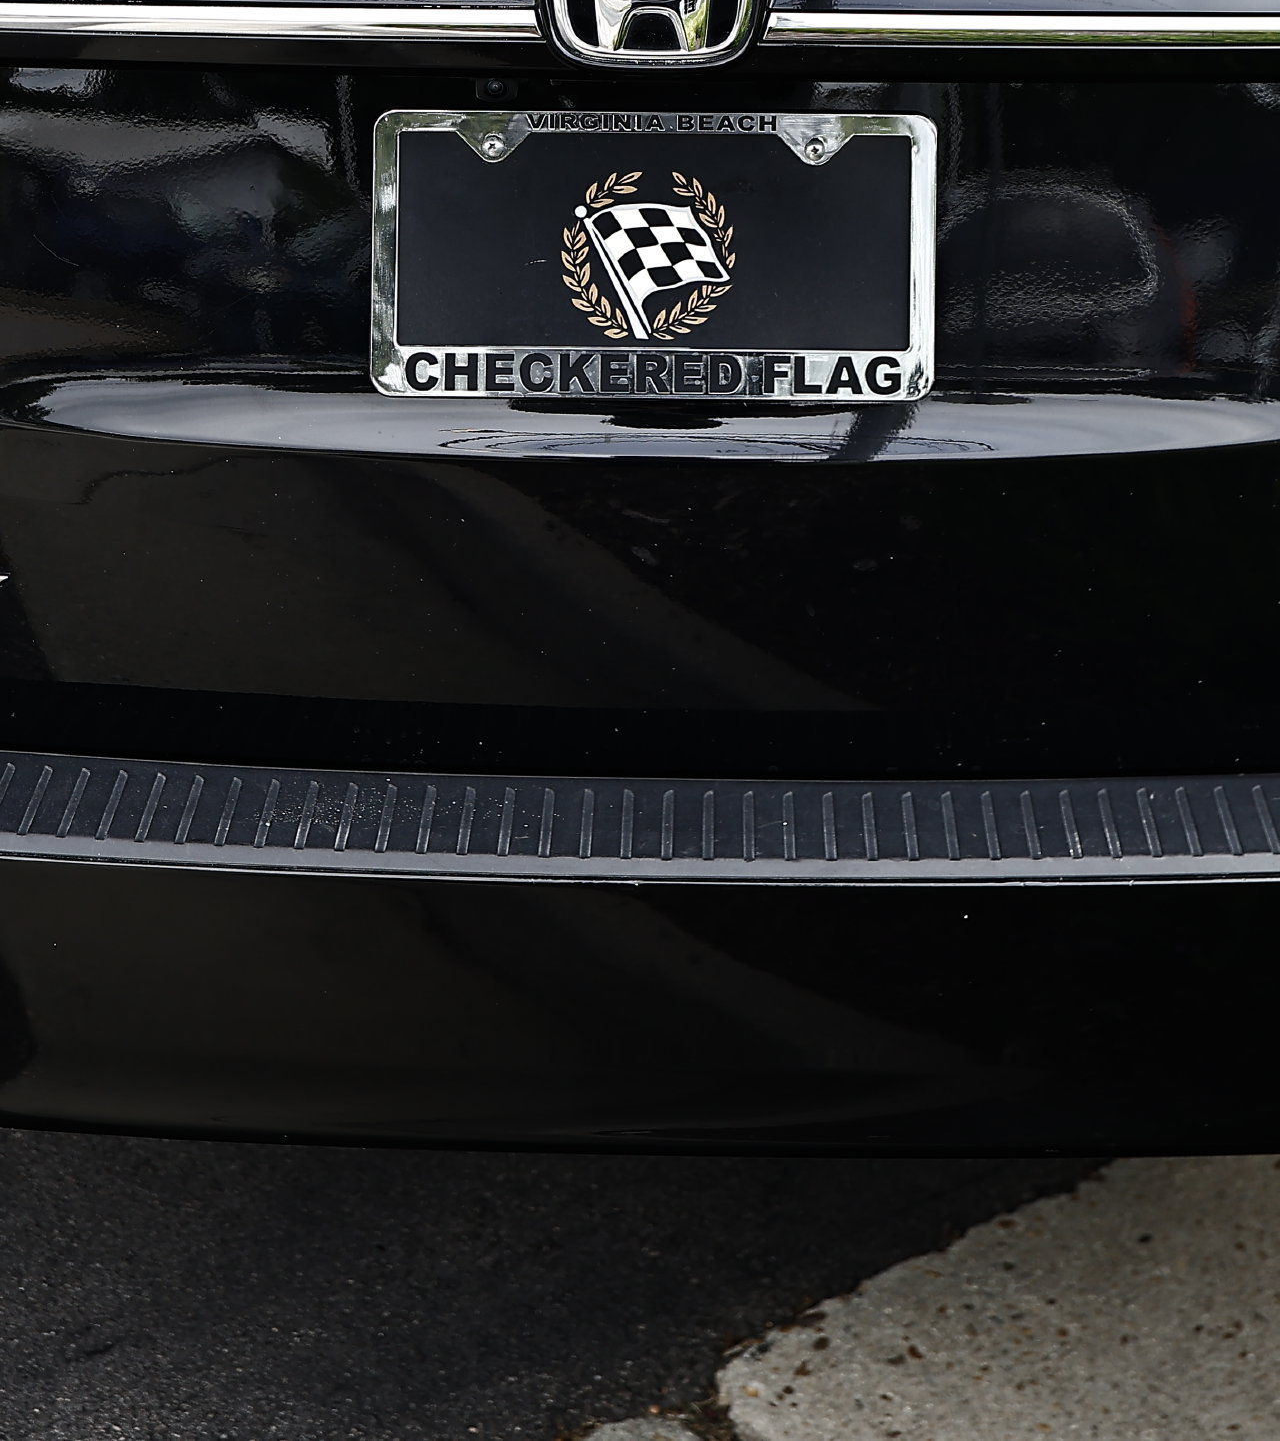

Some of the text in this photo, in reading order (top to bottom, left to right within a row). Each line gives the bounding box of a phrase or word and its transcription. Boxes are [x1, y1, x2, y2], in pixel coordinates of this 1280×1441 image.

[526, 112, 778, 133] VIRGINIA BEACH
[405, 352, 902, 395] CHECKERED FLAG
